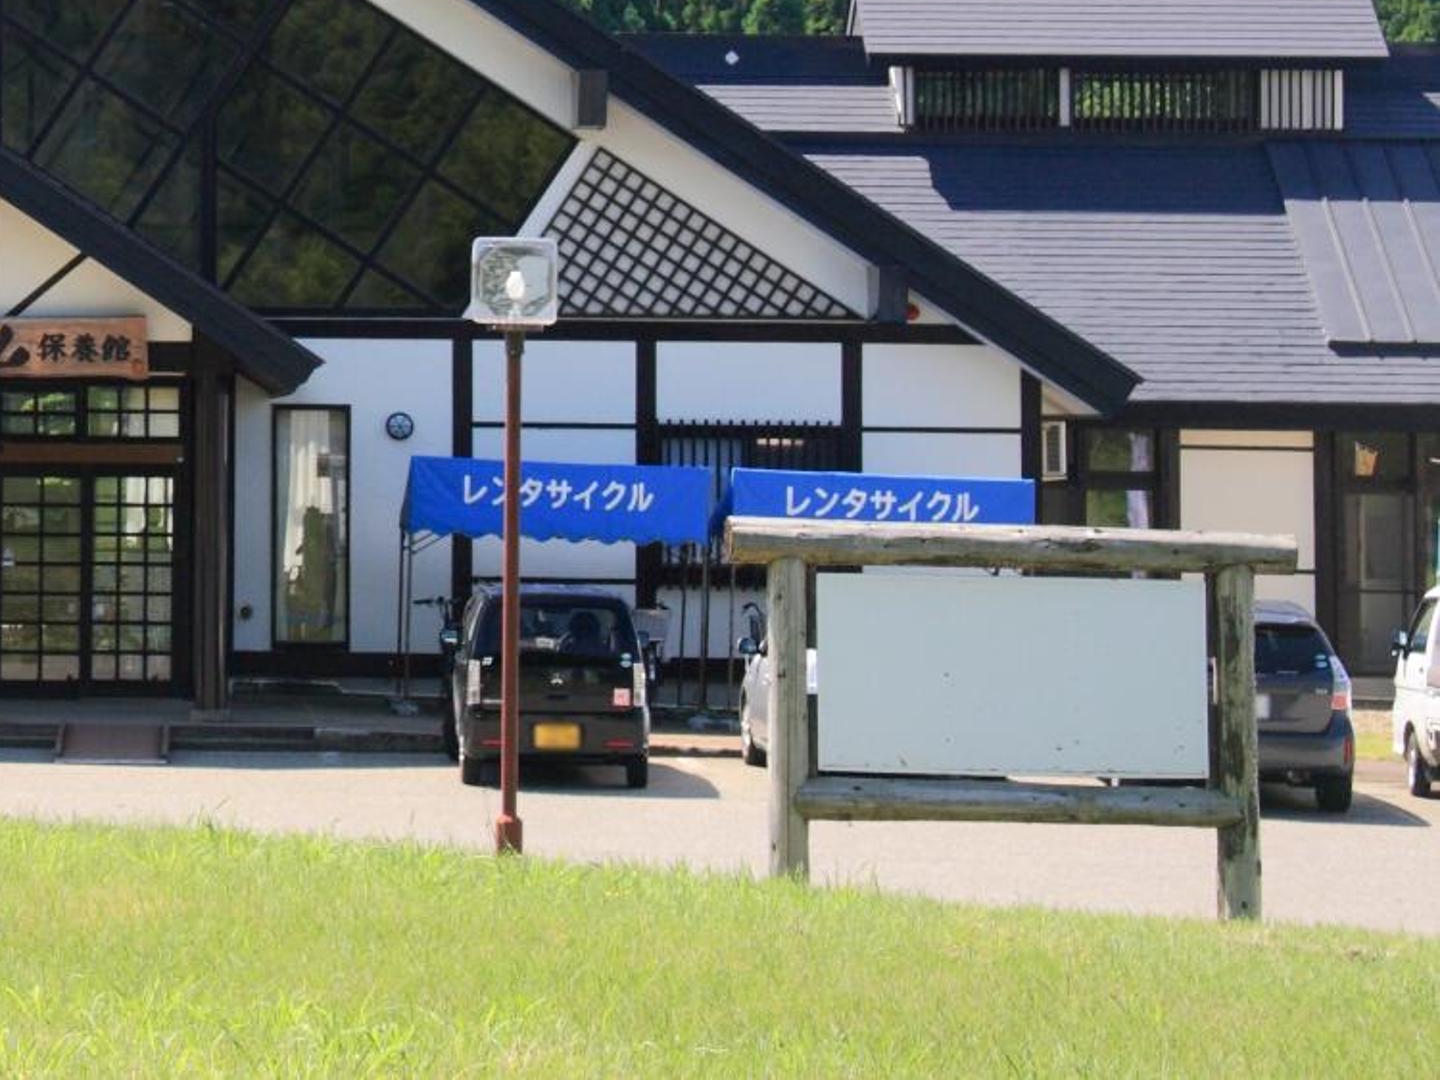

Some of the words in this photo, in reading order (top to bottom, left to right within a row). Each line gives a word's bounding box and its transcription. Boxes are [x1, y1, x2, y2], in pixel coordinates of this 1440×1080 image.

[464, 474, 654, 512] レンタサイクル
[786, 486, 979, 522] レンタサイクル
